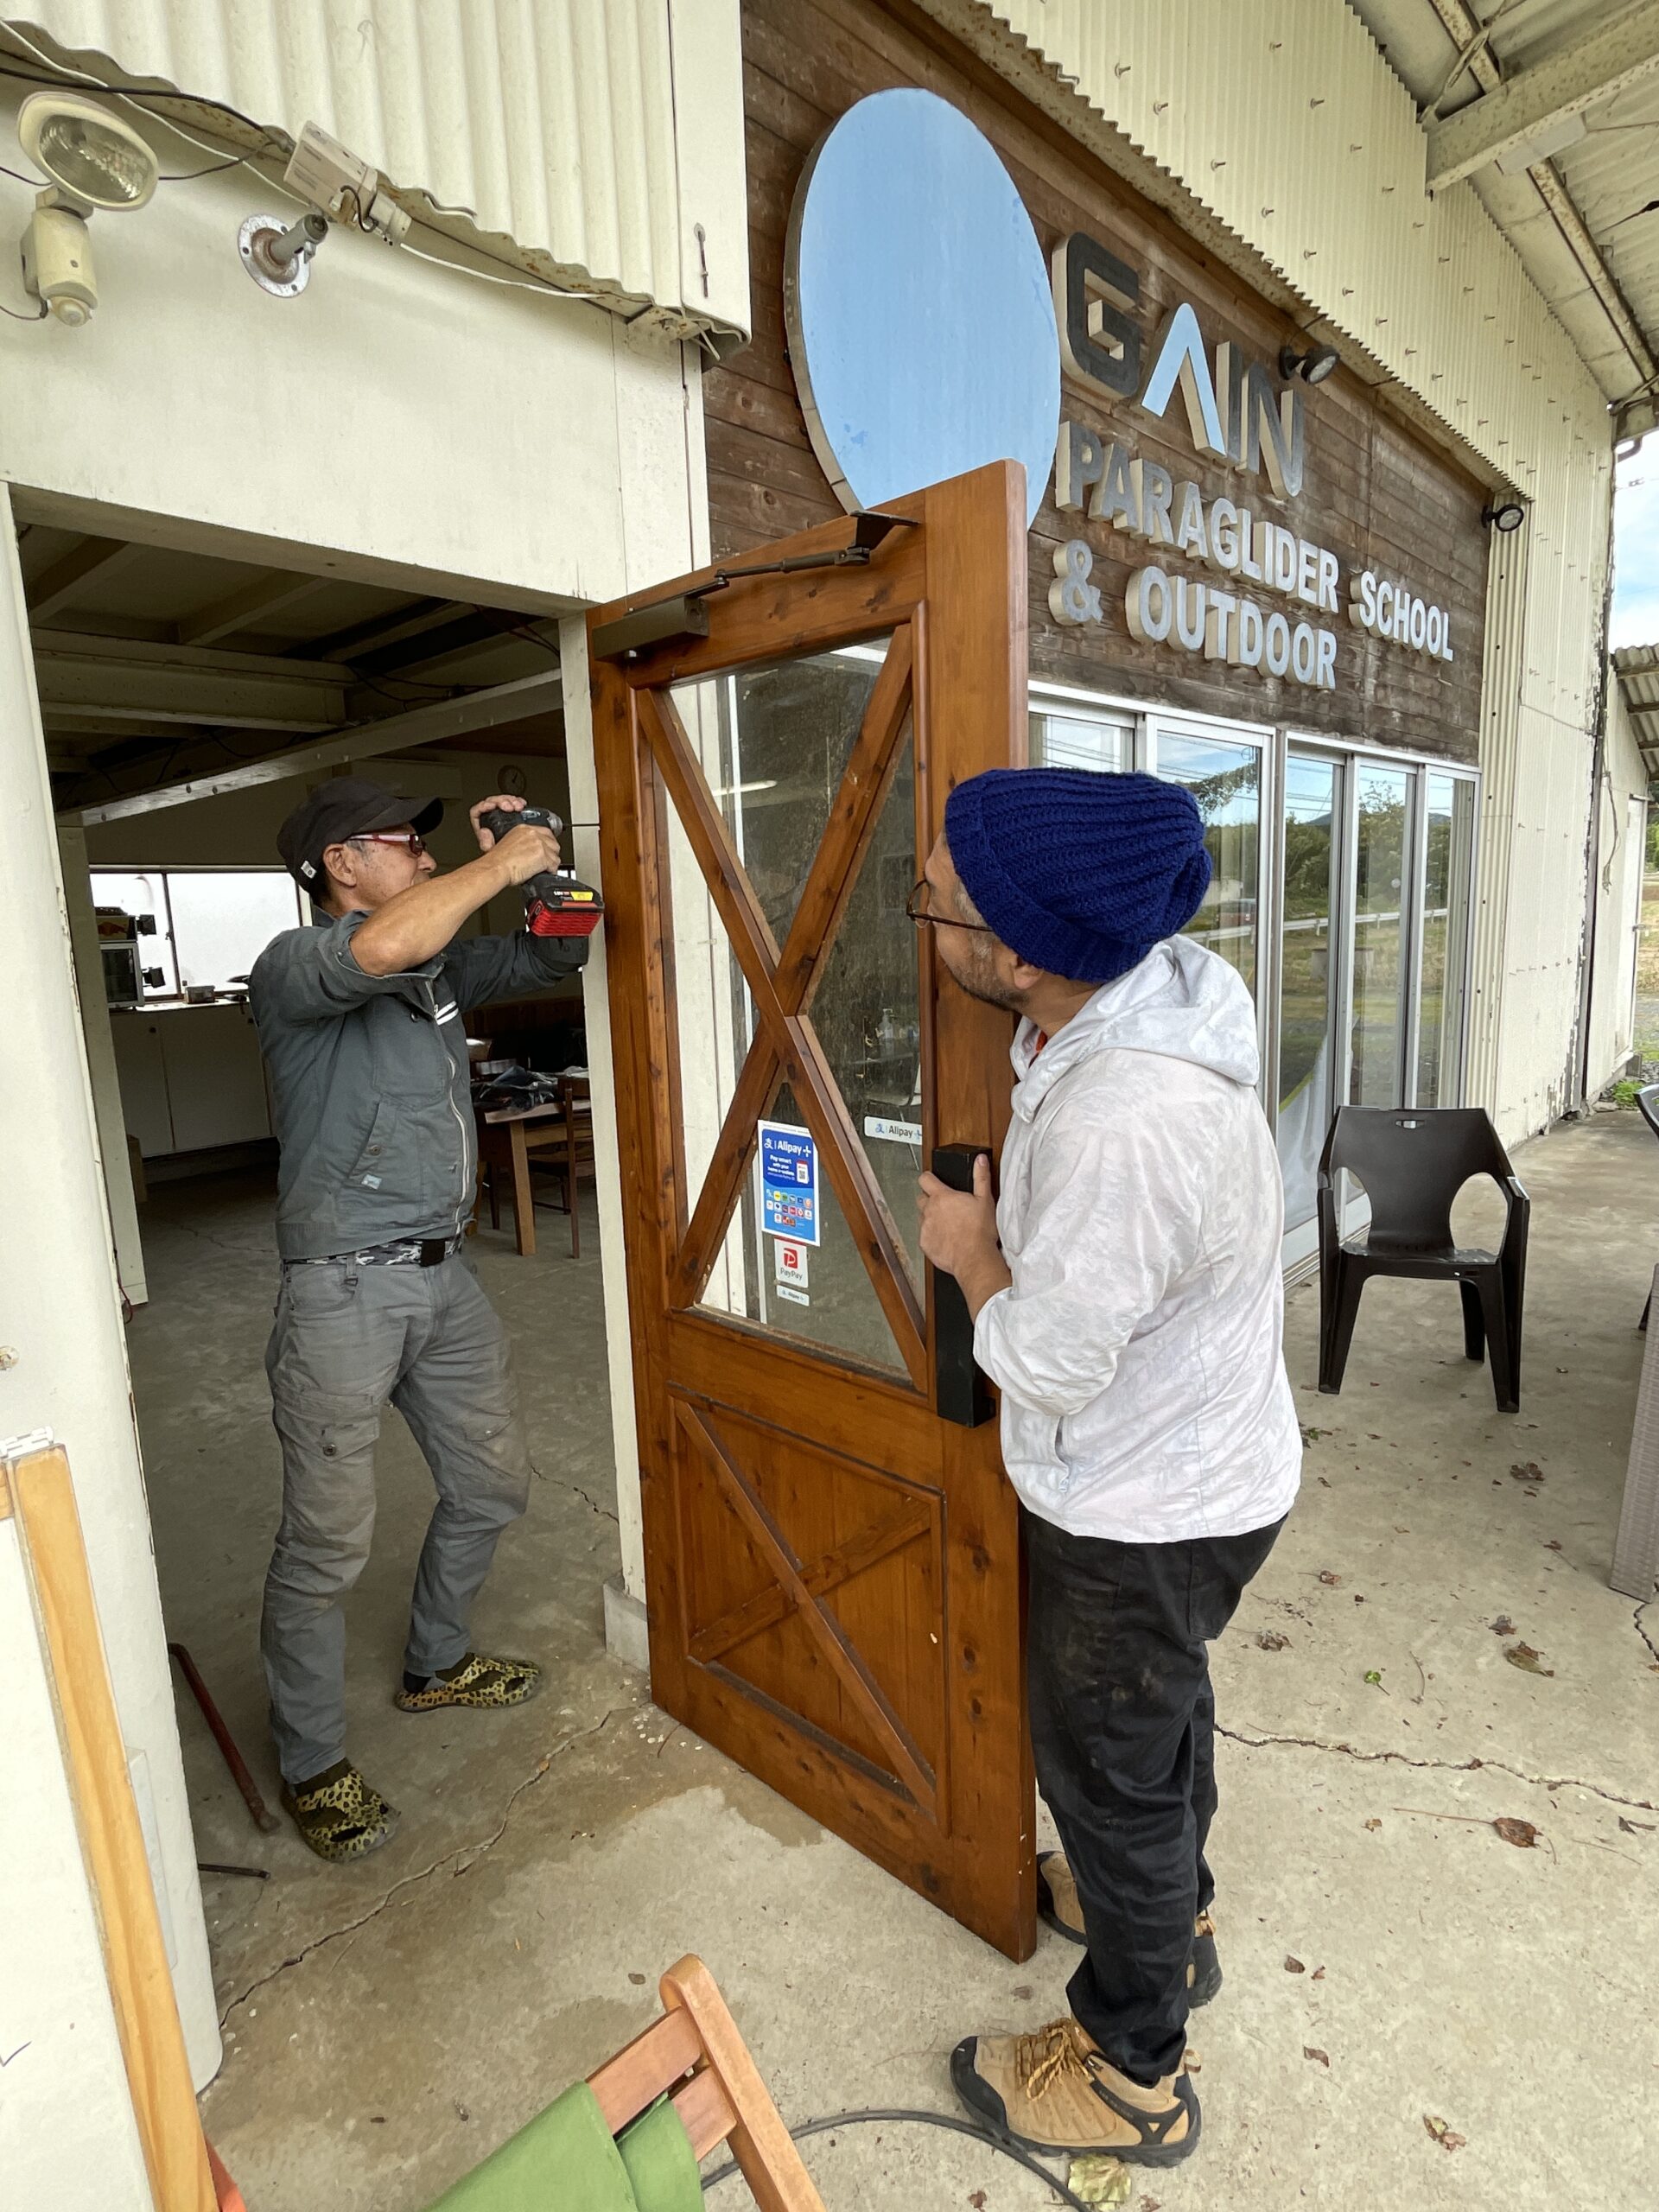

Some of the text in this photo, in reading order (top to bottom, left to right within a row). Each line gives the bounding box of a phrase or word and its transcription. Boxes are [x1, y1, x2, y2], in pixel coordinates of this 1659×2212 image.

[1052, 232, 1304, 498] GAIN
[1048, 539, 1336, 690] & OUTDOOR
[1056, 421, 1453, 663] PARAGLIDER SCHOOL
[780, 1267, 803, 1281] PayPay
